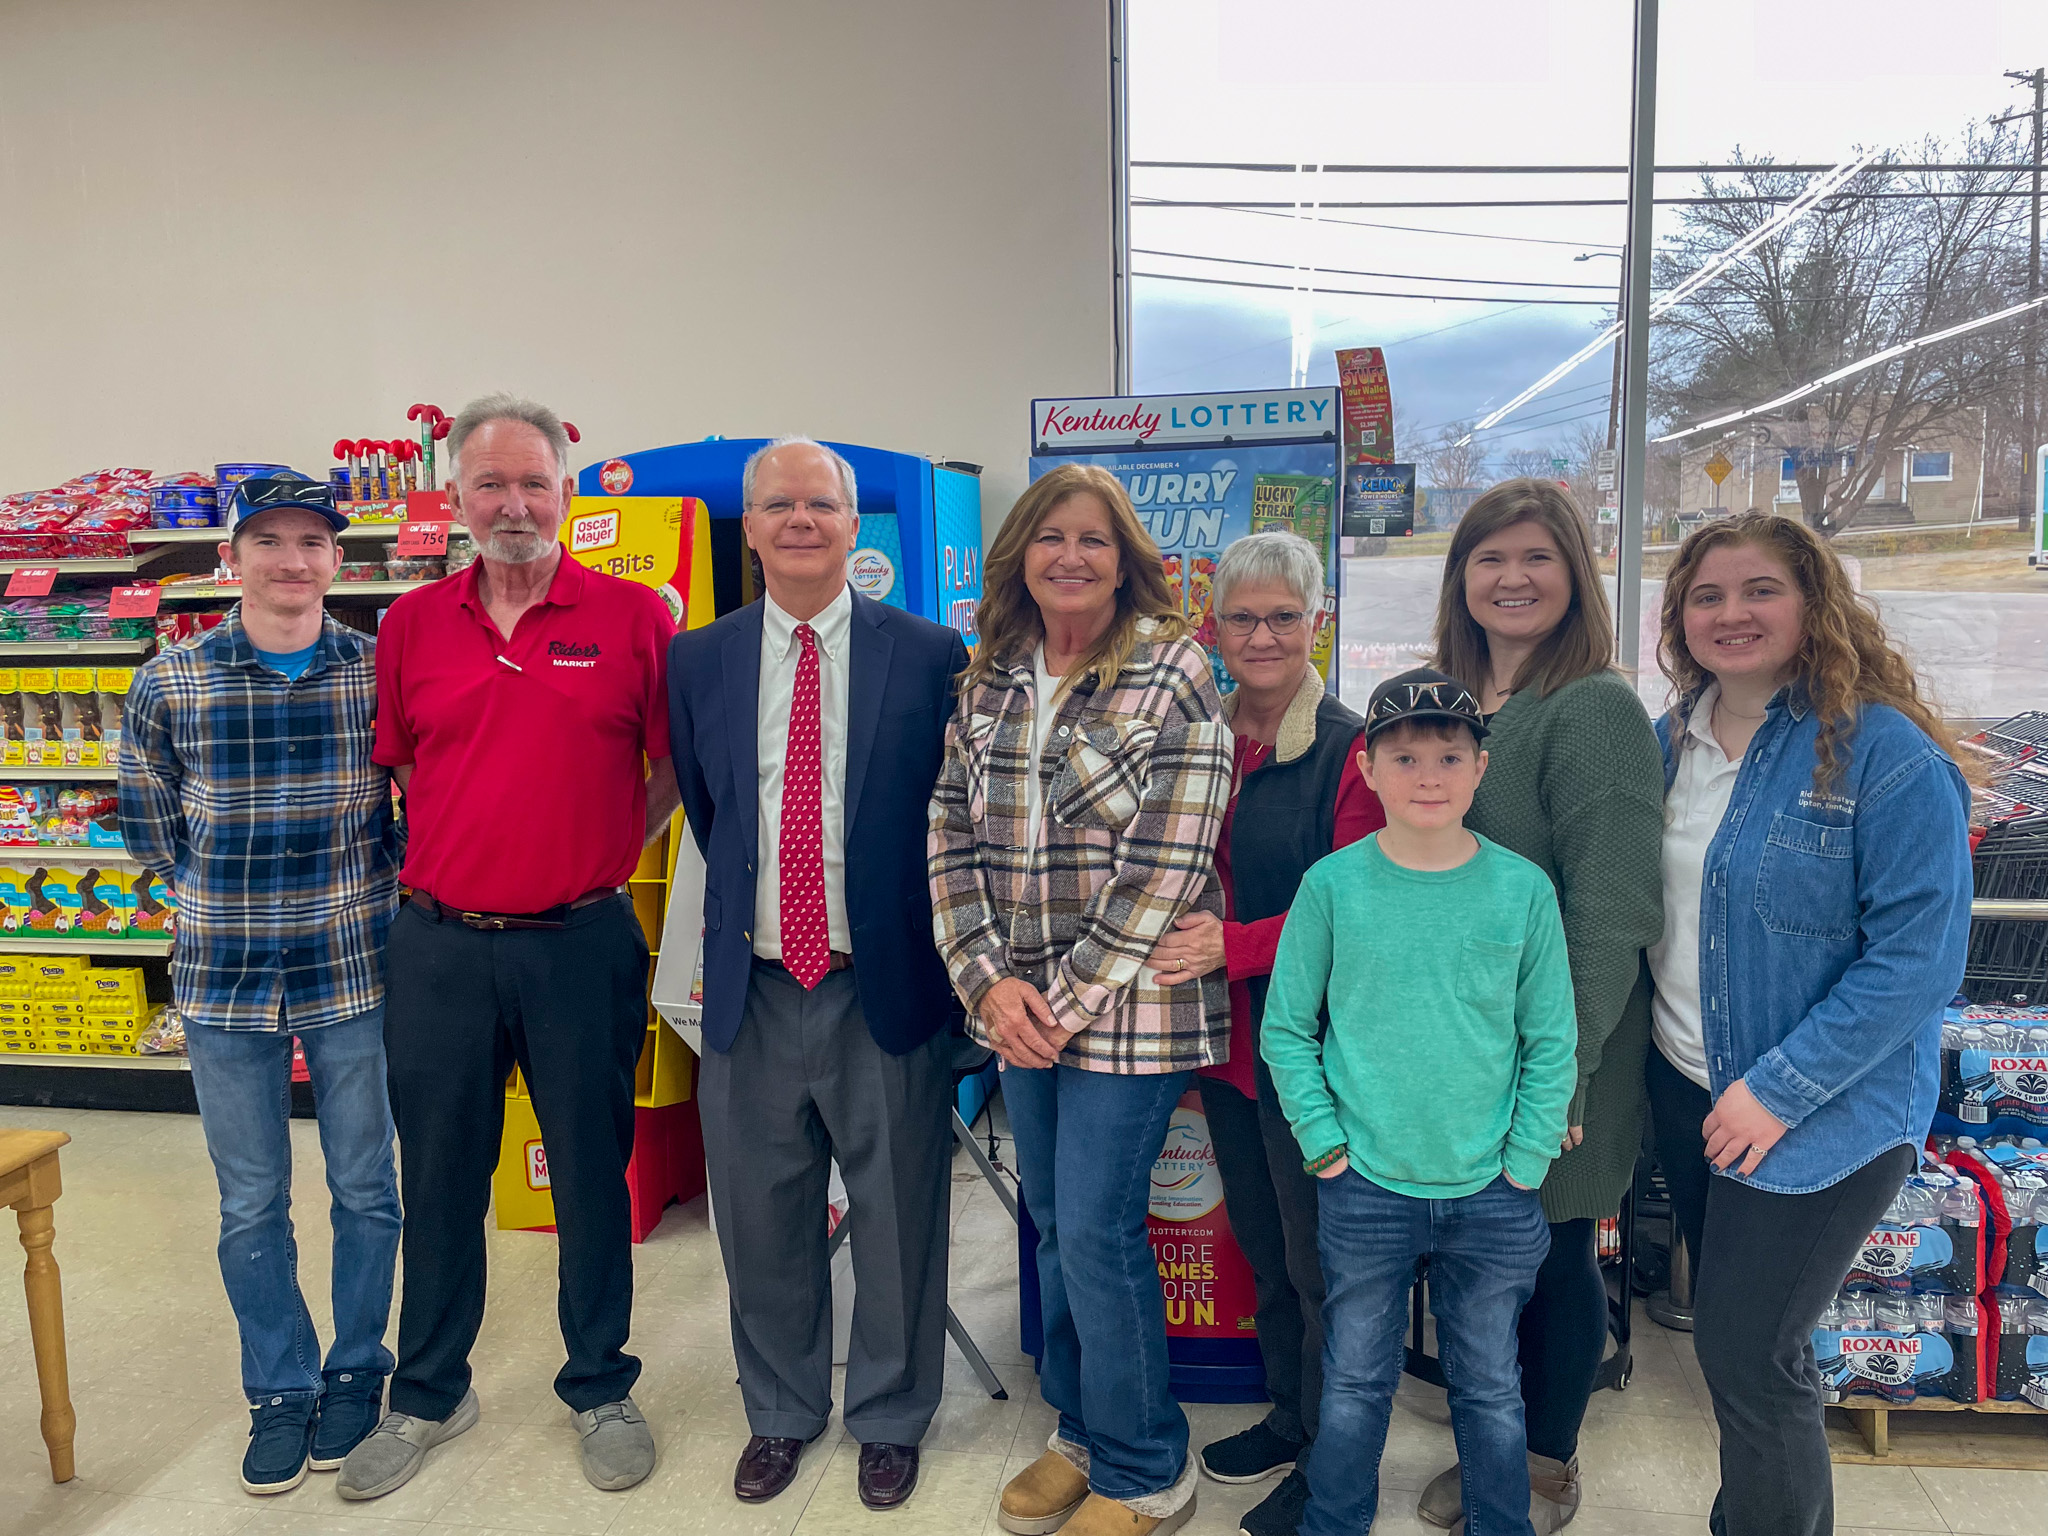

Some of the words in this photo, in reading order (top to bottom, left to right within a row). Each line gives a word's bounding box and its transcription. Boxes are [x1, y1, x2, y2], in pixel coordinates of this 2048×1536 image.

[1342, 366, 1385, 386] STUFF
[1344, 388, 1361, 396] Your
[1362, 385, 1388, 394] Wallet
[1042, 403, 1161, 438] Kentucky
[1171, 399, 1329, 428] LOTTERY
[1103, 463, 1135, 471] VAILABLE
[1136, 462, 1174, 470] DECEMBER
[602, 471, 629, 482] Play
[1128, 470, 1237, 505] URRY
[1360, 478, 1400, 492] KENO
[1256, 485, 1299, 503] LUCKY
[1254, 503, 1296, 519] STREAK
[578, 517, 613, 532] Oscar
[422, 533, 444, 545] 75¢
[576, 528, 613, 545] Mayer
[607, 554, 655, 576] Bits
[853, 565, 889, 576] Kentucky
[944, 545, 978, 591] PLAY
[548, 640, 602, 658] Rider's
[553, 659, 596, 667] MARKET
[1798, 799, 1824, 809] Upton,
[671, 1016, 688, 1026] We
[1991, 1058, 2048, 1072] ROXA
[1995, 1075, 2022, 1098] MOUNTAIN
[1964, 1089, 1983, 1101] 24
[1158, 1143, 1217, 1166] ntucky
[1153, 1162, 1204, 1171] OTTERY
[1865, 1232, 1918, 1246] XANE
[1157, 1262, 1219, 1280] AMES.
[1853, 1260, 1870, 1270] TAIN
[1871, 1266, 1897, 1276] SPRING
[1899, 1251, 1913, 1271] WATER
[1163, 1281, 1214, 1300] ORE
[1166, 1300, 1220, 1326] UN.
[1842, 1338, 1919, 1354] ROXANE
[1846, 1358, 1873, 1379] MOUNTAIN
[1875, 1374, 1903, 1383] SPRING
[1902, 1358, 1916, 1380] WATER
